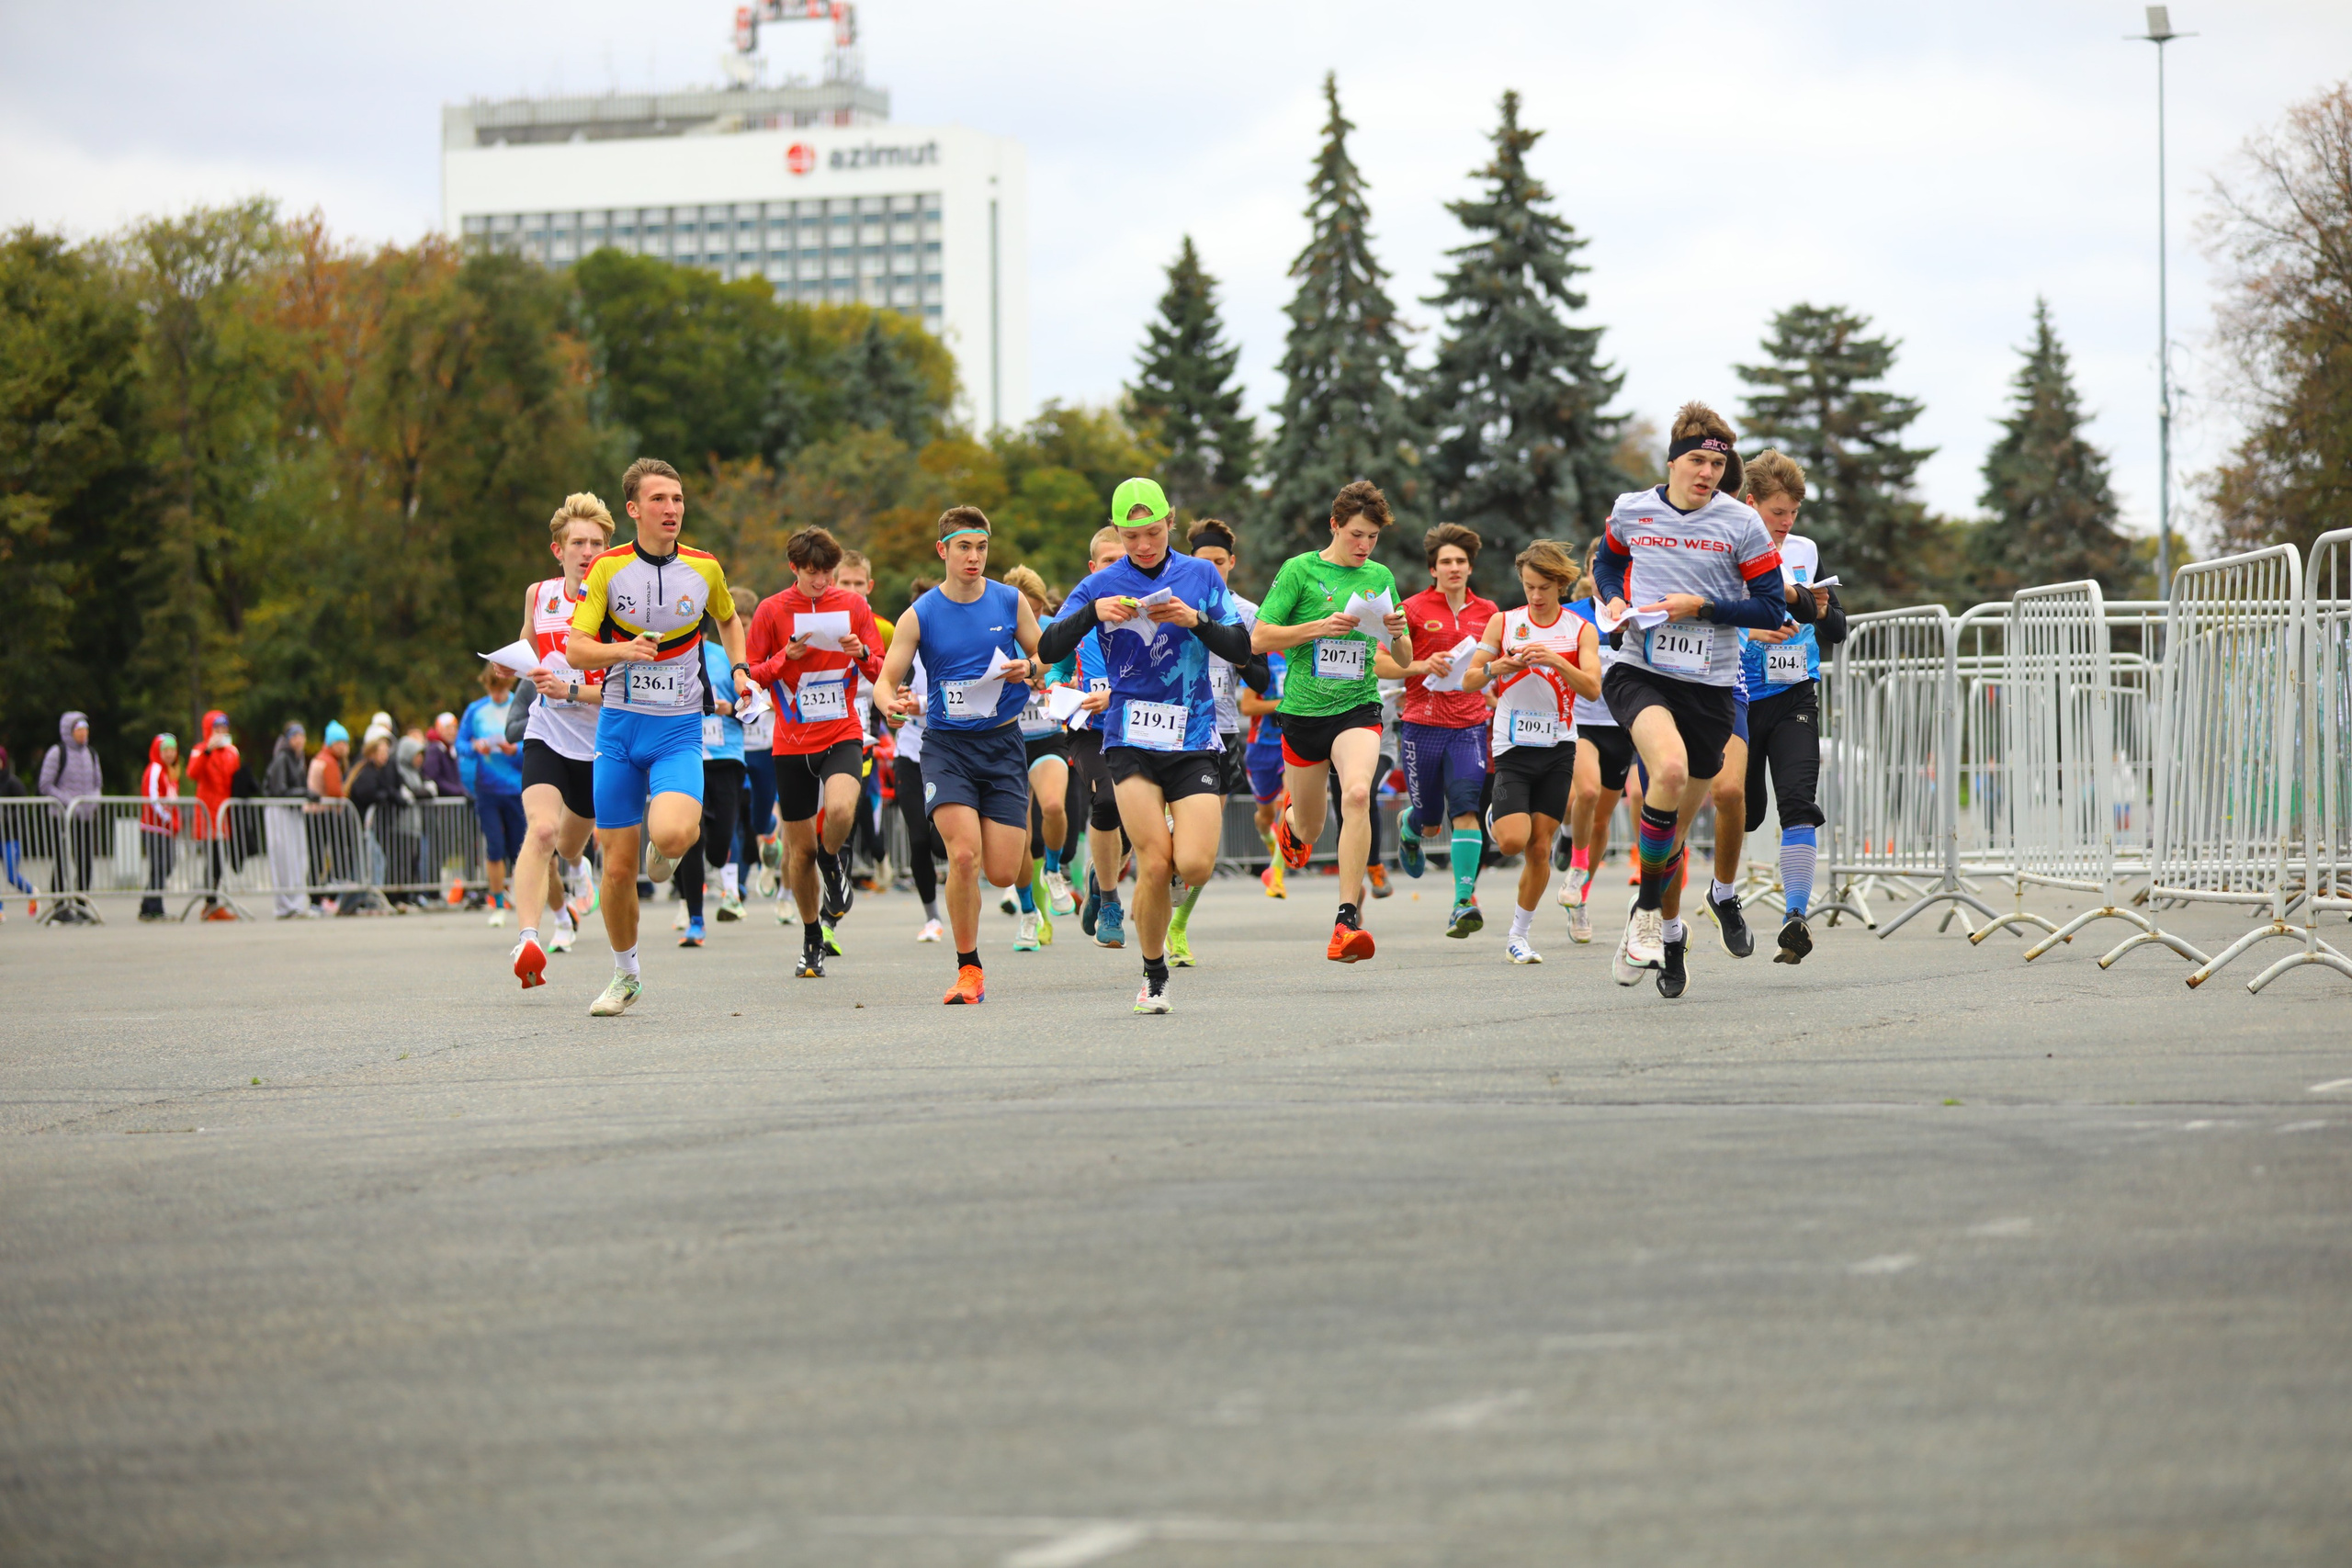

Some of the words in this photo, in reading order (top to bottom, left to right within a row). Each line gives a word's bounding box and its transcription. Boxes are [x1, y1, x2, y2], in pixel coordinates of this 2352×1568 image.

[829, 139, 939, 171] azimut
[1630, 536, 1678, 547] NORD
[1683, 538, 1733, 554] WEST
[1657, 634, 1703, 655] 210.1
[1320, 649, 1357, 664] 207.1
[1769, 656, 1800, 670] 204.
[632, 675, 673, 690] 236.1
[802, 692, 836, 705] 232.1
[948, 691, 965, 705] 22
[1131, 710, 1175, 730] 219.1
[1517, 719, 1551, 734] 209.1
[1404, 739, 1423, 809] FRYAZINO
